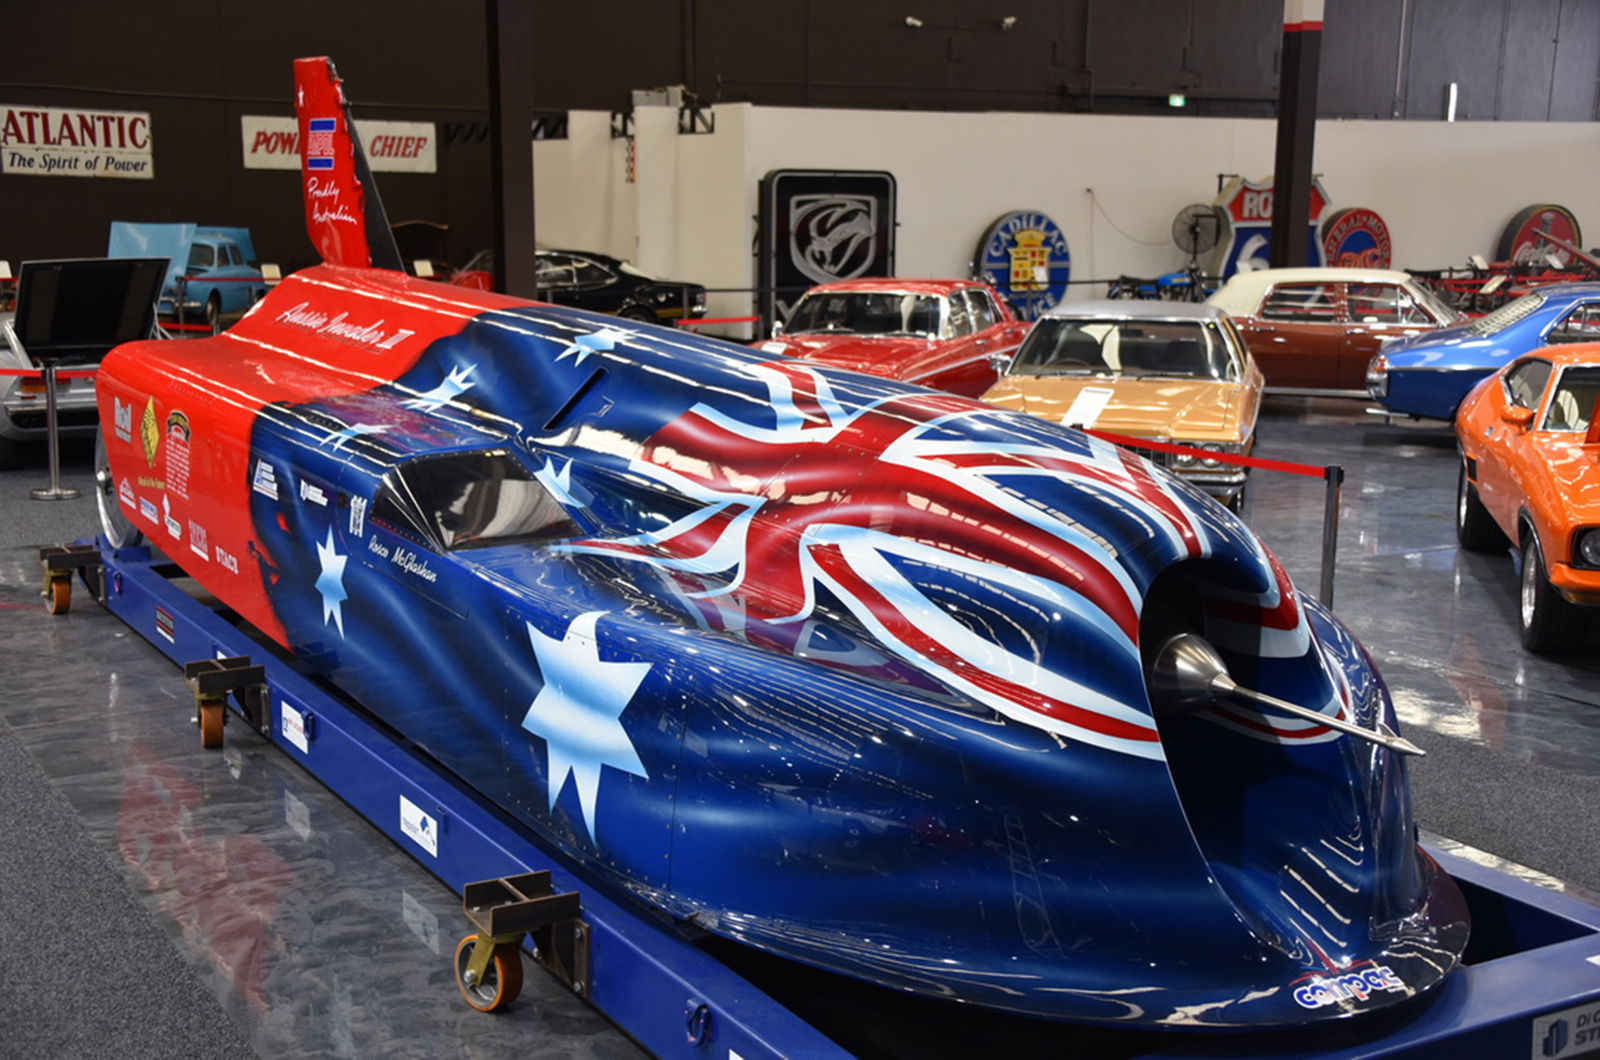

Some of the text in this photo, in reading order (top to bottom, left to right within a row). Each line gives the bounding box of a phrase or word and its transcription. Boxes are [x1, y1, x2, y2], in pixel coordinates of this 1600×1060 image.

[2, 109, 148, 149] ATLANTIC
[251, 130, 427, 158] POW CHIEF
[9, 152, 147, 172] The Spirit of Power
[989, 214, 1067, 257] CADILLAC
[275, 301, 328, 329] Aussie
[316, 312, 385, 345] Invader
[391, 546, 438, 583] McGlashan
